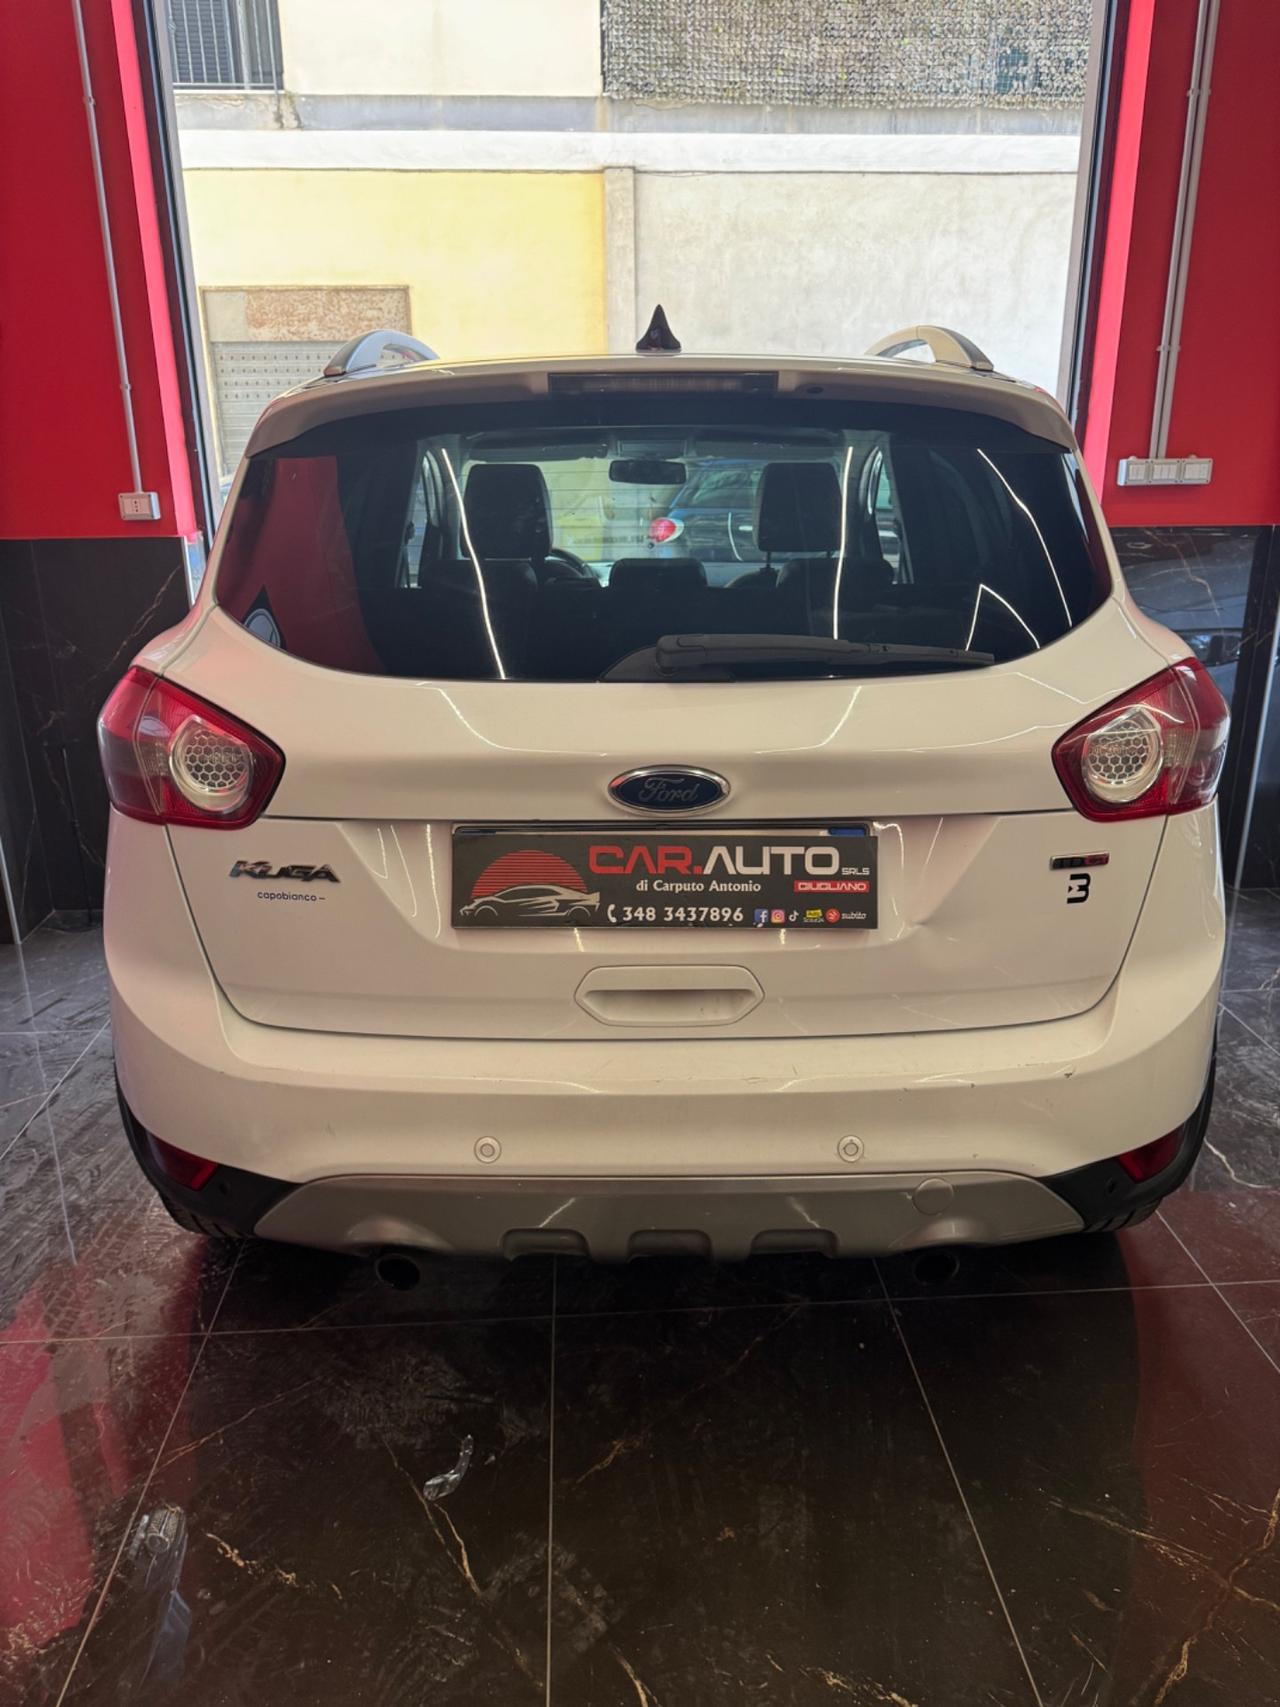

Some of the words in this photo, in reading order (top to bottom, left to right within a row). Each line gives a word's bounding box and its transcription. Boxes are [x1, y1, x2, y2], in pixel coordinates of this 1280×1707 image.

[638, 777, 700, 802] Ford
[229, 860, 341, 883] KUGA
[841, 867, 870, 875] SRLS
[636, 880, 649, 892] di
[653, 880, 705, 894] Carputo
[708, 880, 761, 892] Antonio
[797, 882, 867, 891] GIUGLIANO
[257, 891, 317, 901] capobianco
[622, 907, 656, 922] 348
[664, 907, 744, 922] 3437896
